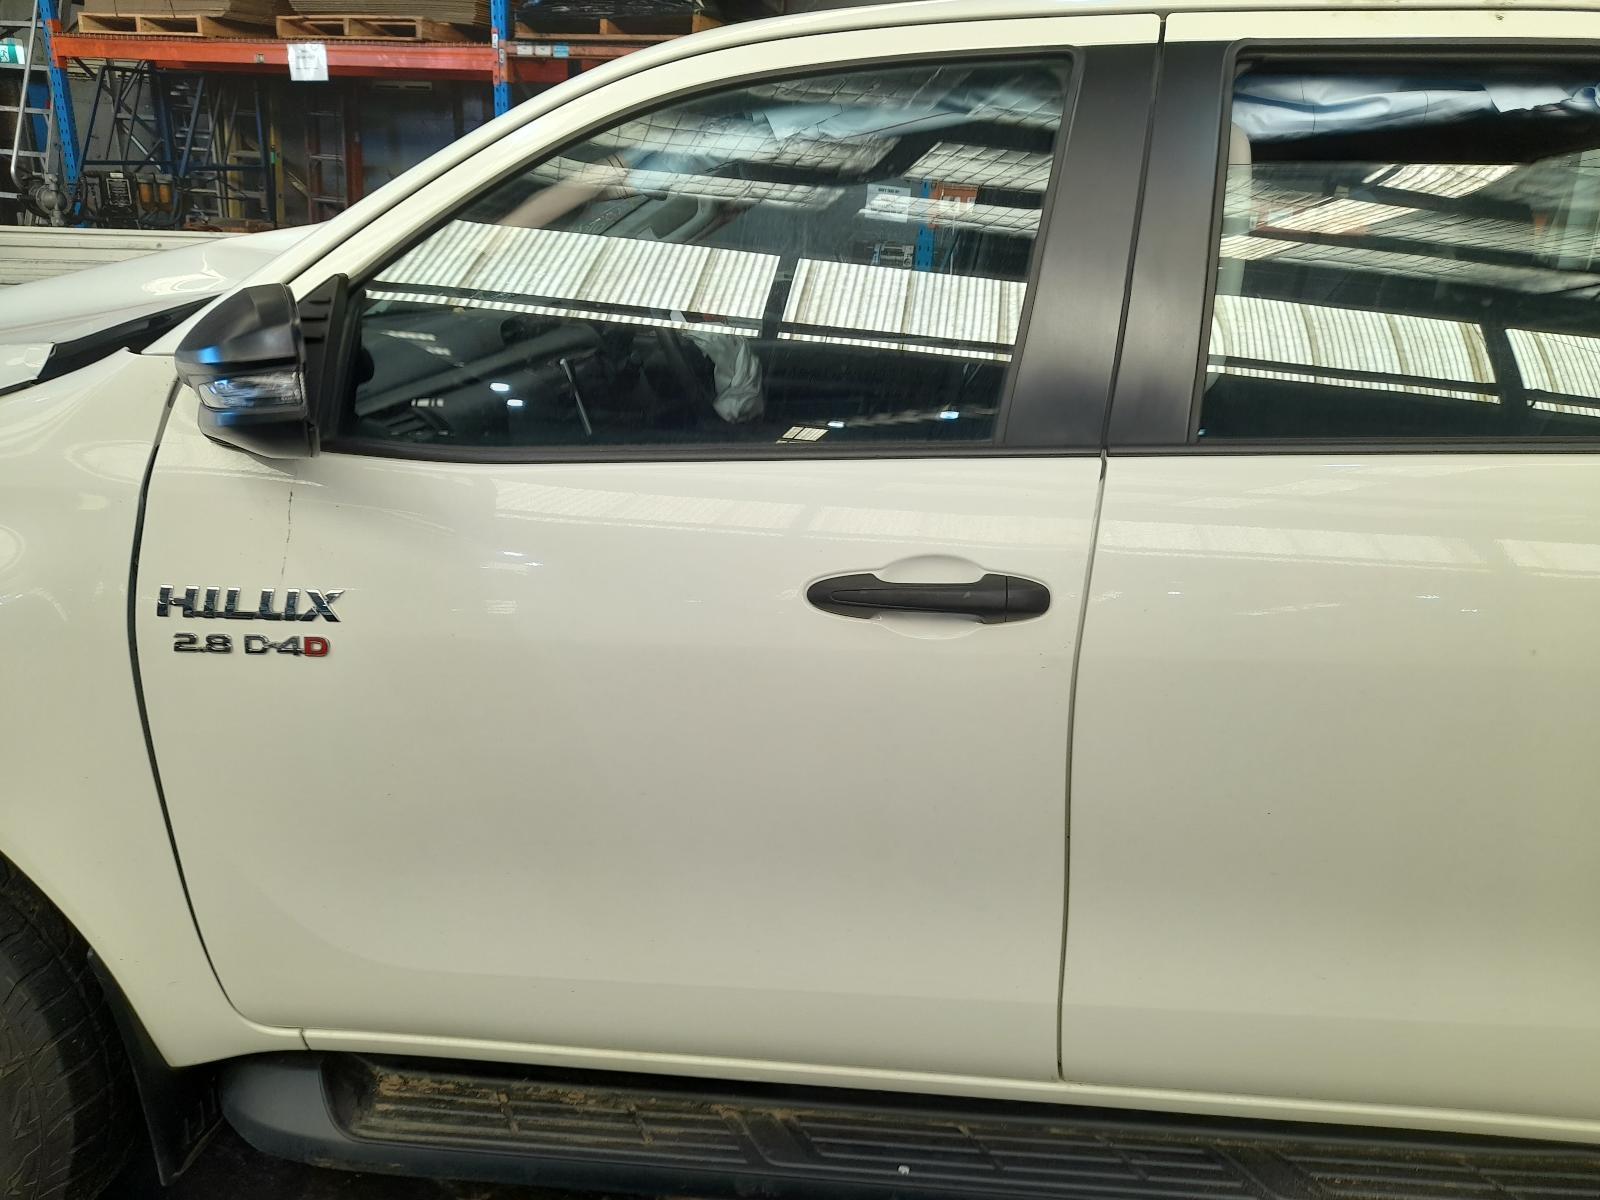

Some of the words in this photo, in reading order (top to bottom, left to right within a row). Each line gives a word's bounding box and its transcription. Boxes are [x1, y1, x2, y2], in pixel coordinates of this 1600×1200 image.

[157, 584, 345, 622] HILUX
[173, 633, 232, 654] 2.8
[244, 634, 330, 657] D-4D
